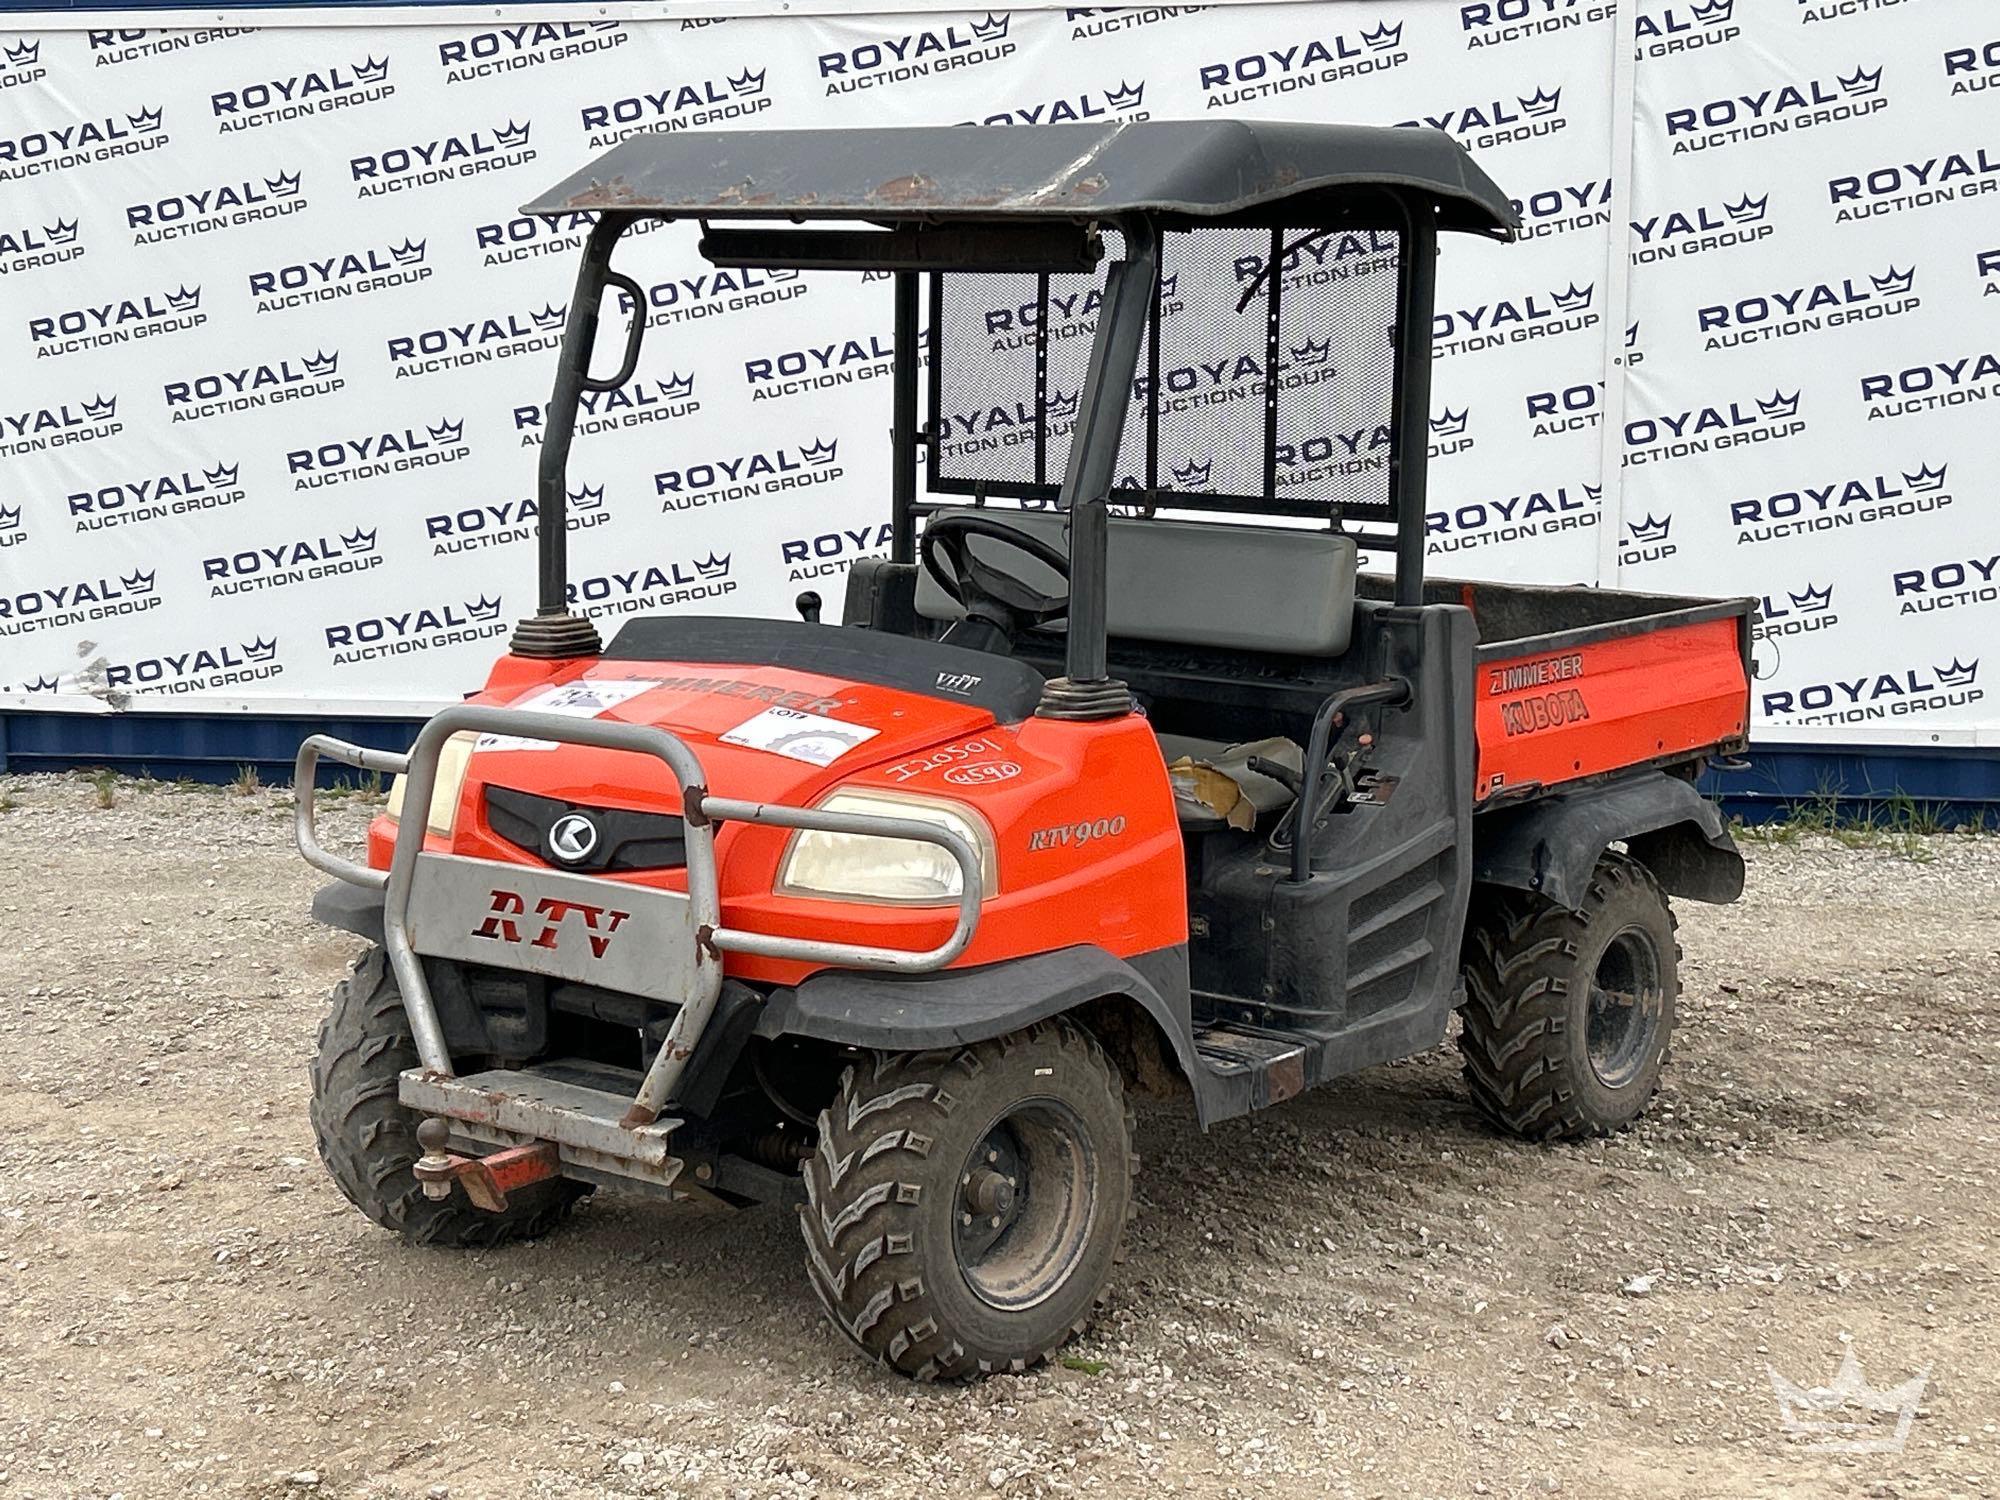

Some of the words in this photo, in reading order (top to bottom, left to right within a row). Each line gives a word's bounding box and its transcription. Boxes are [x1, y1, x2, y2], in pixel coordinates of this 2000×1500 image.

[439, 21, 589, 66] ROYAL
[1072, 6, 1182, 40] AUCTION
[1468, 13, 1580, 50] AUCTION
[1649, 27, 1740, 57] GROUP
[96, 35, 189, 67] AUCTION
[447, 52, 545, 84] AUCTION
[550, 33, 627, 60] GROUP
[819, 27, 971, 77] ROYAL
[826, 63, 928, 96] AUCTION
[934, 43, 1016, 72] GROUP
[1200, 36, 1361, 90] ROYAL
[3, 69, 46, 87] OUP
[211, 69, 353, 116] ROYAL
[1207, 74, 1315, 109] AUCTION
[1322, 53, 1408, 82] GROUP
[220, 103, 314, 134] AUCTION
[319, 86, 394, 112] GROUP
[582, 81, 728, 131] ROYAL
[693, 98, 771, 125] GROUP
[1395, 102, 1518, 140] YAL
[1666, 81, 1837, 136] ROYAL
[1673, 119, 1788, 155] AUCTION
[1795, 98, 1887, 128] GROUP
[0, 118, 128, 161] ROYAL
[1478, 119, 1566, 148] GROUP
[0, 152, 90, 181] AUCTION
[95, 135, 169, 160] GROUP
[350, 133, 494, 181] ROYAL
[358, 168, 454, 198] AUCTION
[460, 150, 536, 176] GROUP
[127, 183, 266, 228] ROYAL
[135, 216, 228, 246] AUCTION
[233, 200, 307, 224] GROUP
[1514, 210, 1610, 240] UCTION
[1629, 208, 1724, 243] YAL
[1836, 188, 1954, 223] AUCTION
[476, 209, 592, 249] ROYA
[1682, 225, 1773, 254] GROUP
[13, 247, 84, 271] GROUP
[484, 236, 581, 266] AUCTION
[249, 251, 391, 296] ROYAL
[257, 284, 352, 313] AUCTION
[357, 268, 432, 292] GROUP
[29, 297, 166, 341] ROYAL
[729, 285, 807, 310] GROUP
[1698, 280, 1870, 332] ROYAL
[38, 330, 129, 358] AUCTION
[134, 314, 206, 338] GROUP
[388, 316, 531, 361] ROYAL
[1427, 333, 1504, 363] CTION
[1511, 314, 1599, 342] GROUP
[1429, 296, 1551, 343] OYAL
[1705, 317, 1821, 351] AUCTION
[1827, 298, 1920, 326] GROUP
[396, 349, 492, 379] AUCTION
[745, 333, 893, 383] ROYAL
[1861, 354, 2000, 401] ROYA
[164, 362, 304, 405] ROYAL
[172, 395, 265, 423] AUCTION
[270, 379, 344, 403] GROUP
[753, 371, 852, 401] AUCTION
[1868, 387, 1986, 420] AUCTION
[0, 406, 83, 439] YAL
[514, 384, 658, 429] RYAL
[623, 402, 700, 426] GROUP
[1625, 403, 1756, 445] OYAL
[0, 438, 46, 457] TION
[51, 423, 122, 446] GROUP
[287, 430, 428, 473] ROYAL
[1276, 423, 1390, 470] ROYA
[1715, 422, 1805, 449] GROUP
[295, 463, 389, 491] AUCTION
[395, 447, 470, 471] GROUP
[655, 450, 800, 495] ROYAL
[663, 484, 760, 512] AUCTION
[765, 468, 843, 492] GROUP
[68, 473, 205, 516] ROYAL
[76, 506, 167, 533] AUCTION
[172, 491, 245, 514] GROUP
[1731, 476, 1902, 525] ROYAL
[426, 495, 539, 539] ROYA
[1427, 524, 1537, 555] AUCTION
[1543, 511, 1601, 533] GRO
[1738, 513, 1853, 544] AUCTION
[1860, 495, 1952, 522] GROUP
[203, 539, 342, 580] ROYAL
[434, 528, 529, 556] AUCTION
[782, 517, 893, 564] ROYA
[211, 571, 304, 597] AUCTION
[309, 556, 383, 579] GROUP
[1894, 556, 2000, 596] ROY
[90, 597, 161, 619] GROUP
[568, 596, 655, 620] UCTION
[660, 582, 736, 605] GROUP
[1900, 588, 1997, 615] AUCTIO
[326, 606, 466, 648] ROYAL
[334, 638, 427, 665] AUCTION
[432, 624, 507, 647] GROUP
[106, 647, 243, 688] ROYAL
[210, 665, 283, 687] GROUP
[1489, 653, 1584, 696] ZIMMERER
[1501, 689, 1590, 736] KUBOTA
[1763, 670, 1934, 716] ROYAL
[1891, 690, 1983, 715] GROUP
[1029, 816, 1127, 851] RTV900
[471, 890, 630, 959] RTV
